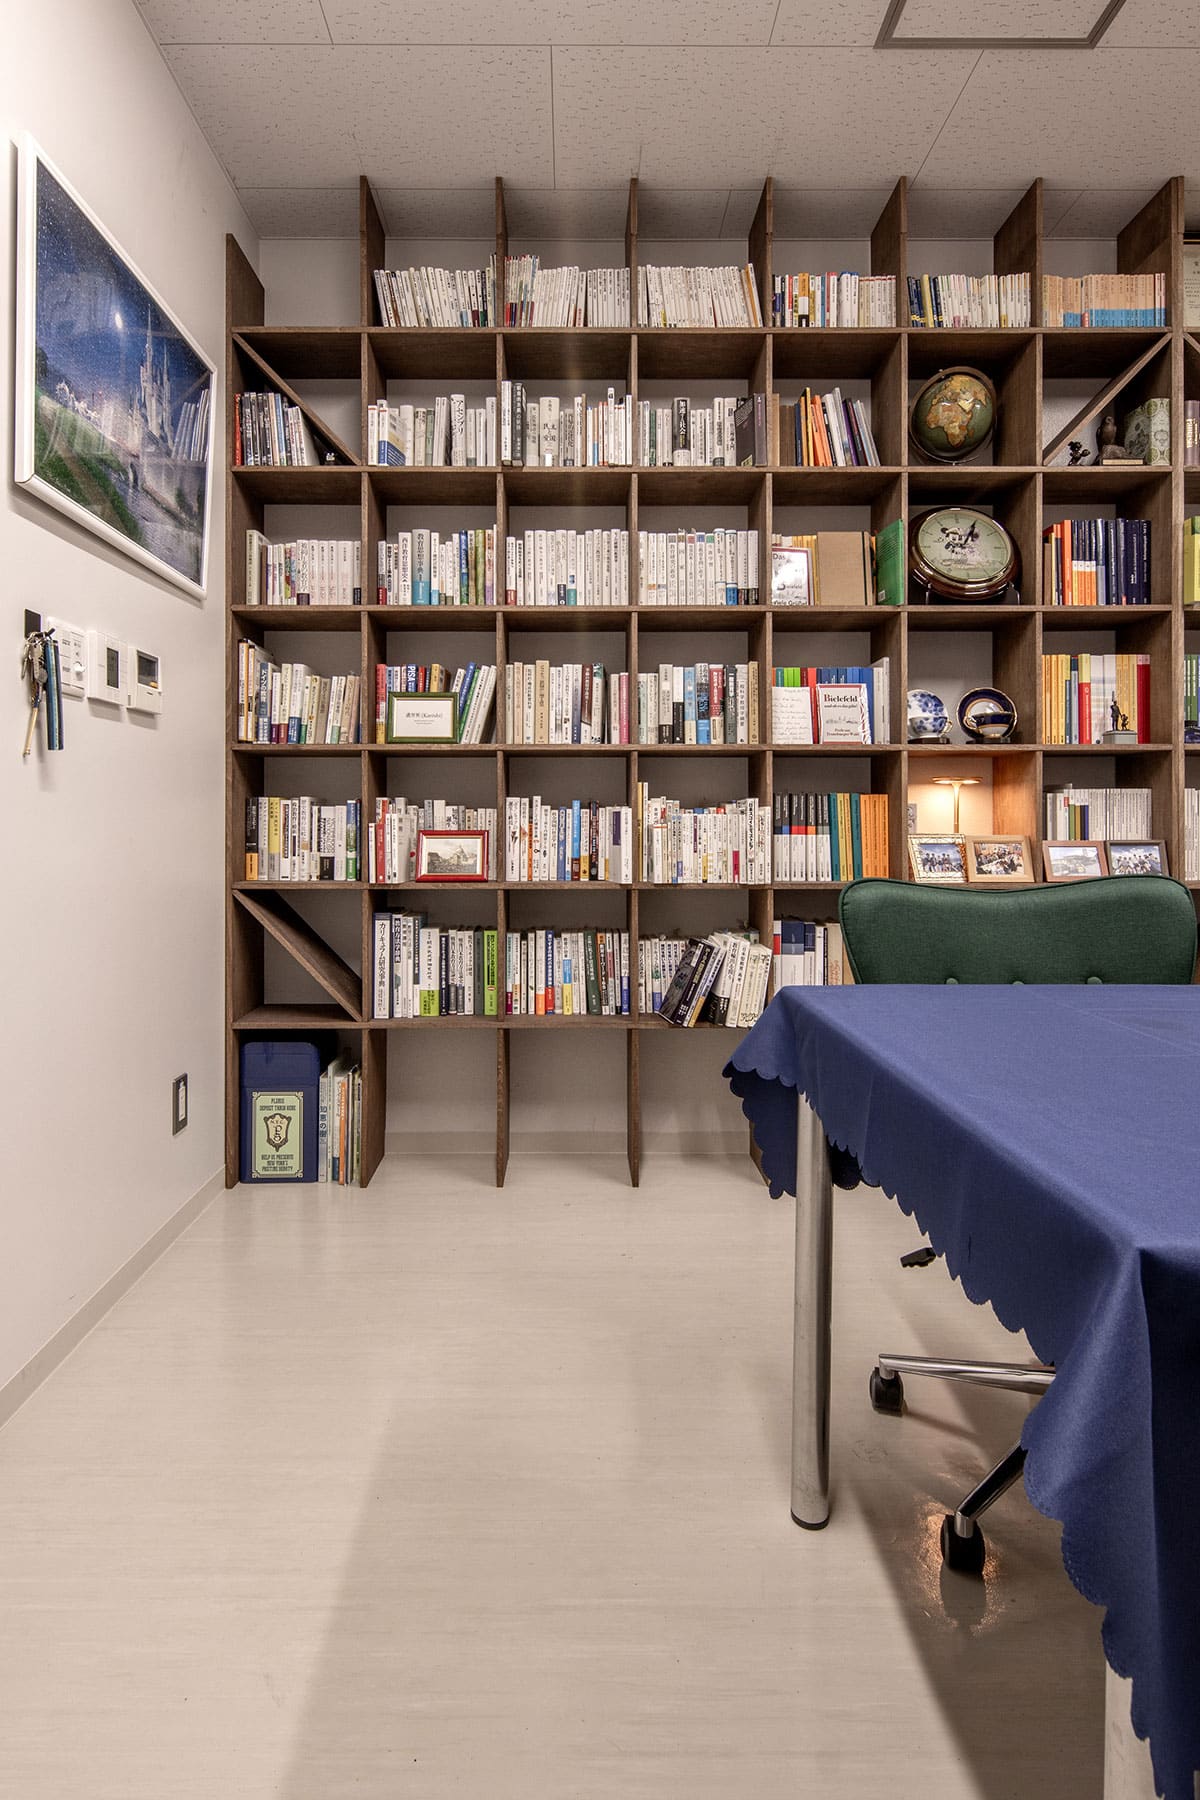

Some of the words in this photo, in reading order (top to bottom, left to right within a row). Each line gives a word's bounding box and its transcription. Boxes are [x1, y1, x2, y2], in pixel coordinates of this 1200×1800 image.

[456, 399, 465, 434] アセンブリ
[678, 400, 687, 435] 加速する社会
[417, 533, 425, 574] 教育思想事典
[407, 665, 416, 682] PISA
[823, 694, 858, 703] Bielefeld
[378, 922, 386, 988] カリキュラム研究事典
